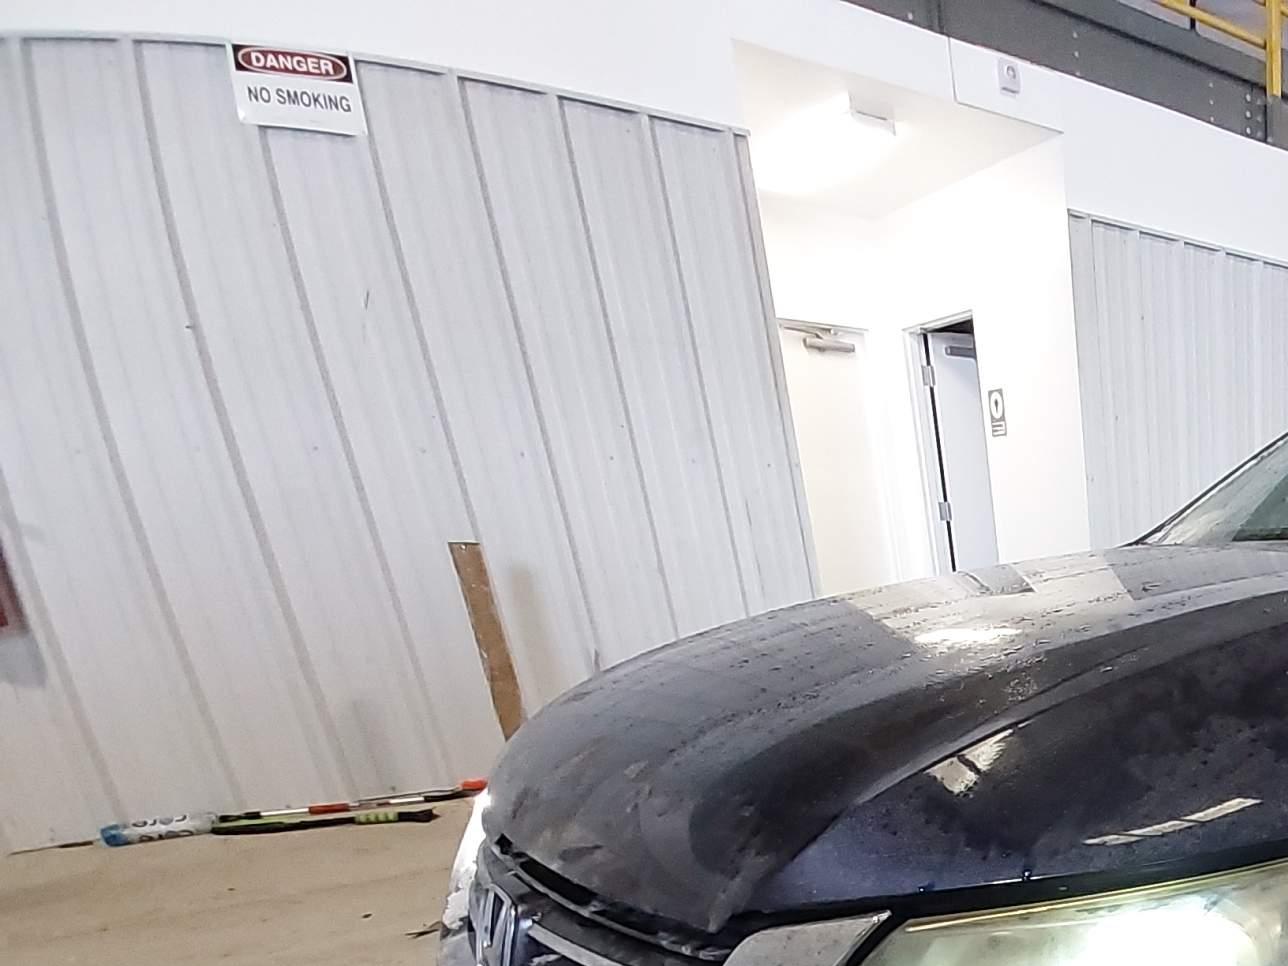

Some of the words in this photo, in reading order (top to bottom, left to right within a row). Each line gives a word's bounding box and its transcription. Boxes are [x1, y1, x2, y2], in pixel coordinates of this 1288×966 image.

[250, 52, 335, 75] DANGER
[247, 85, 271, 104] NO
[275, 88, 352, 112] SMOKING
